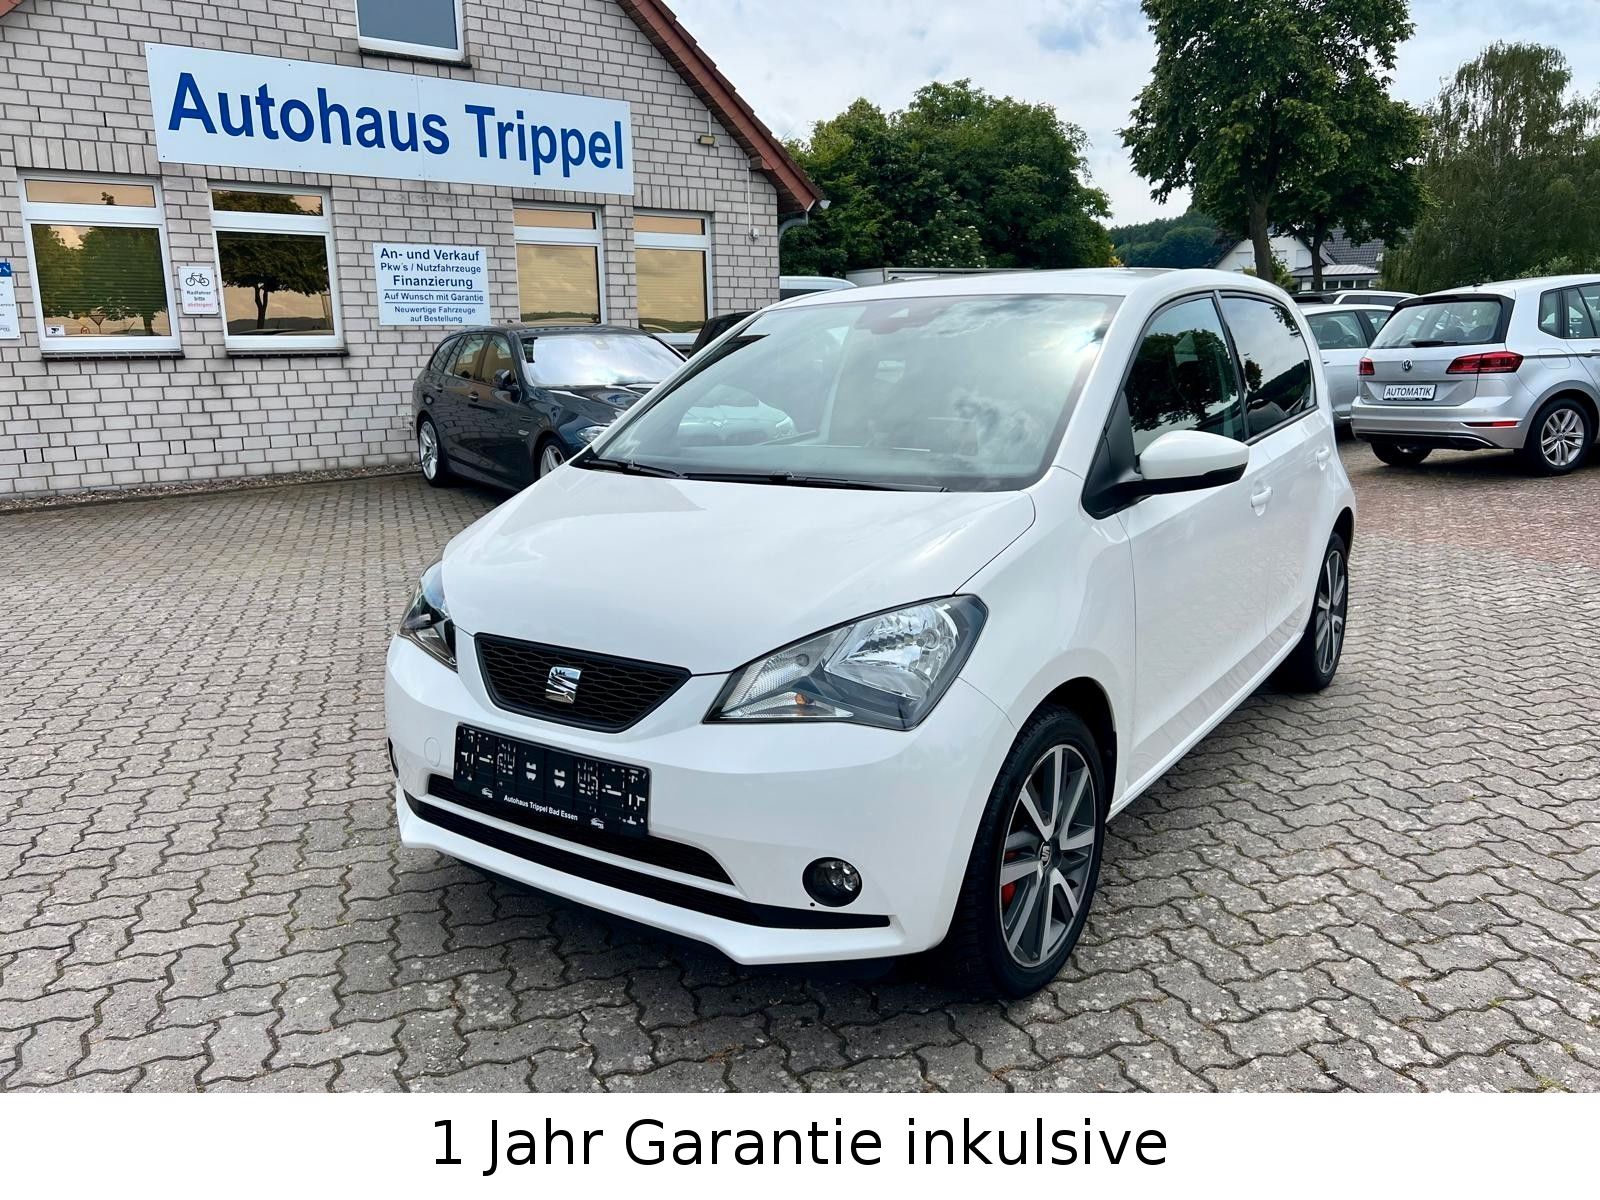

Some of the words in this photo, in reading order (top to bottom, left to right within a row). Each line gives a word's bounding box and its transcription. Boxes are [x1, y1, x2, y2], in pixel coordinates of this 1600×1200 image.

[168, 72, 450, 155] Autohaus
[465, 104, 623, 178] Trippel
[380, 248, 403, 259] An-
[406, 249, 430, 260] und
[433, 249, 480, 261] Verkauf
[416, 263, 481, 274] Nutzfahrzeuge
[393, 275, 473, 289] Finanzierung
[384, 292, 399, 300] Auf
[400, 293, 434, 301] Wunsch
[436, 293, 449, 301] mit
[450, 293, 484, 302] Garantie
[394, 306, 437, 315] Neuwertige
[438, 306, 476, 315] Fahrzeuge
[423, 315, 463, 323] Bestellung
[1385, 387, 1432, 397] AUTOMATIK
[503, 794, 529, 807] Autohaus
[529, 801, 548, 813] Trippel
[548, 807, 560, 816] Bad
[560, 810, 578, 821] Essen
